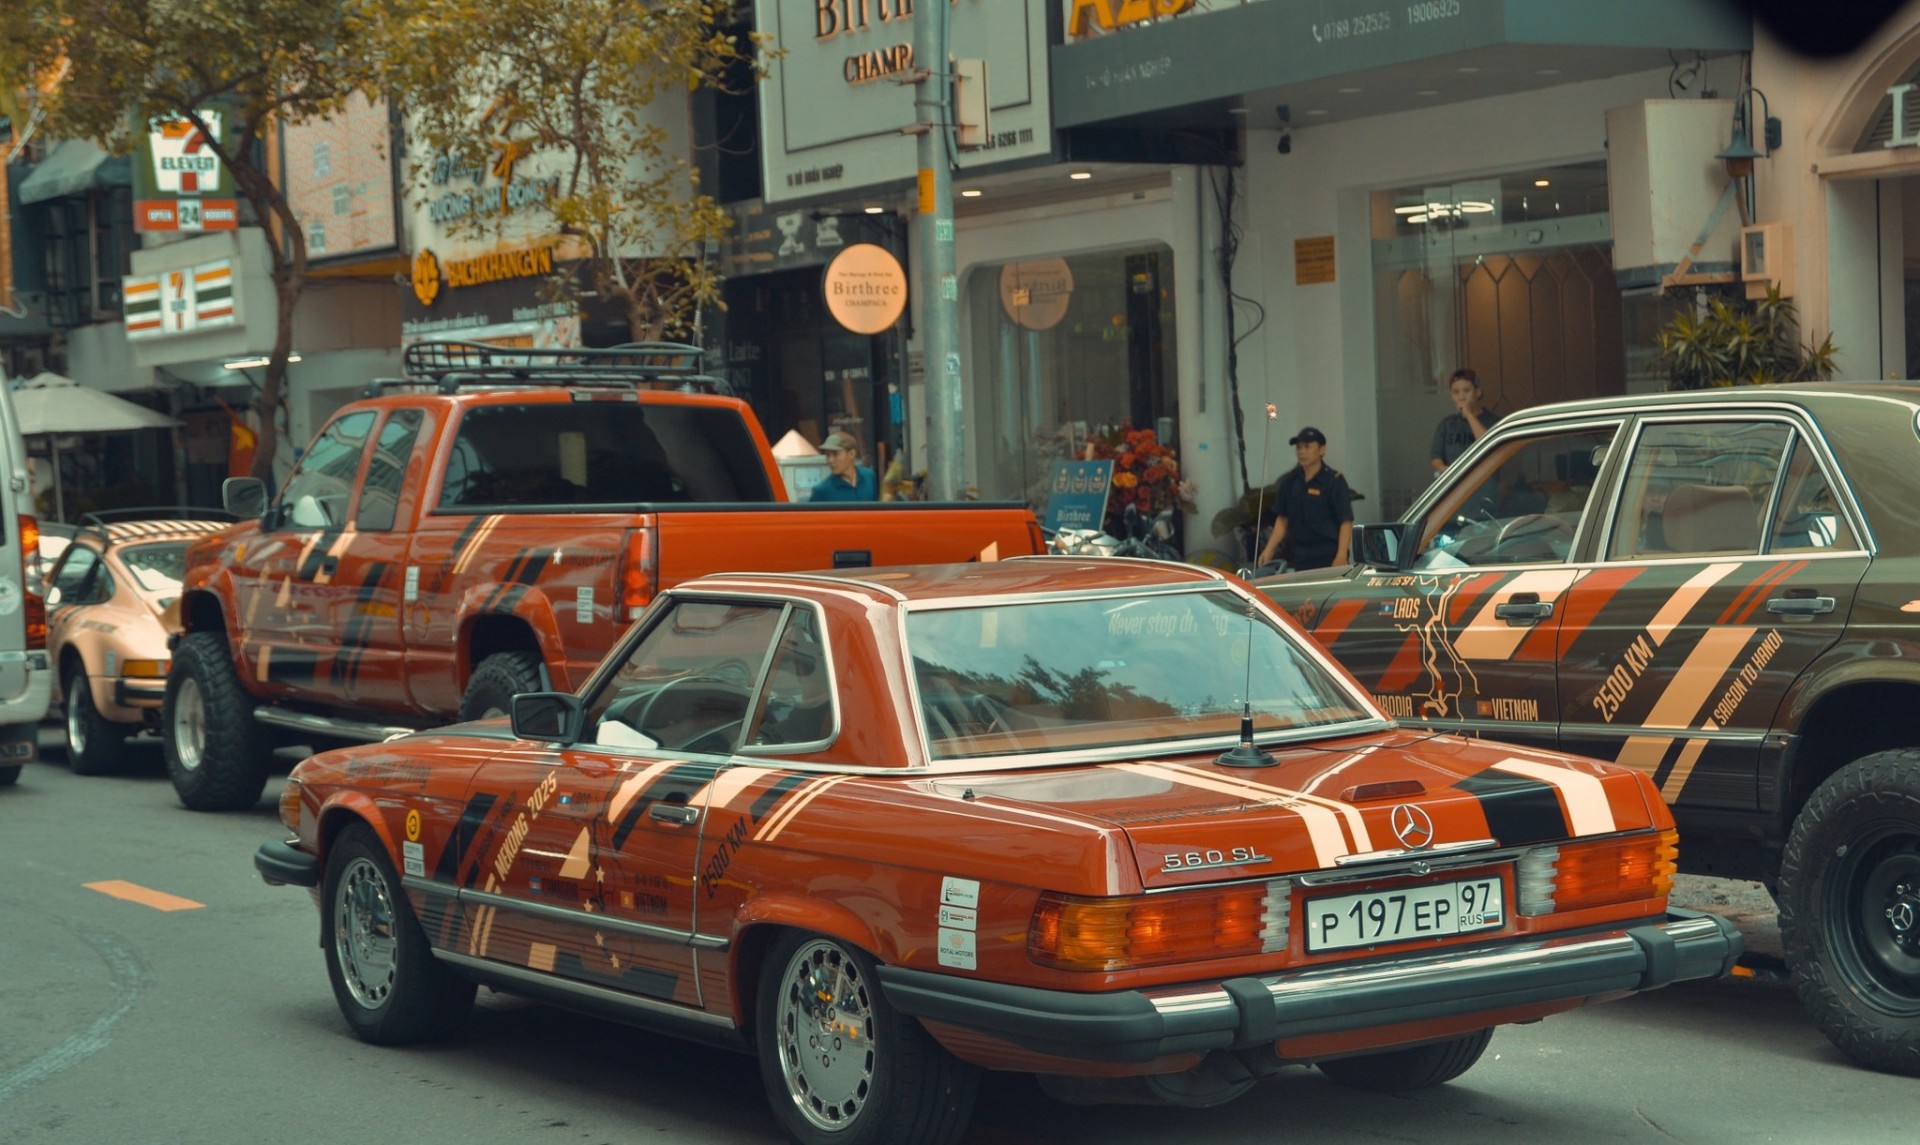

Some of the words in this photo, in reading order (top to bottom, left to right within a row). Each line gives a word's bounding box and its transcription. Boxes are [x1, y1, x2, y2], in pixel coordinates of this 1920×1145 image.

[1407, 0, 1460, 24] 19006925
[1324, 19, 1349, 40] 0789
[1352, 11, 1391, 36] 252525
[180, 206, 199, 224] 24
[833, 281, 899, 295] Birthree
[1393, 597, 1420, 619] LAOS
[1108, 612, 1146, 636] Never
[1147, 612, 1178, 637] stop
[1592, 663, 1634, 724] 2500
[1623, 634, 1655, 678] KM
[1713, 677, 1748, 726] SAIGON
[1739, 663, 1758, 686] TO
[1751, 628, 1784, 672] HANOI
[1372, 696, 1413, 717] MBODIA
[1491, 698, 1539, 722] VIETNAM
[494, 812, 529, 883] MEKONG
[526, 769, 558, 820] 2025
[701, 842, 730, 899] 2500
[726, 816, 748, 855] KM
[1163, 849, 1224, 870] 560
[1232, 846, 1264, 862] SL
[1461, 882, 1490, 914] 97
[1460, 913, 1483, 927] RUS
[955, 949, 974, 958] MOTORS
